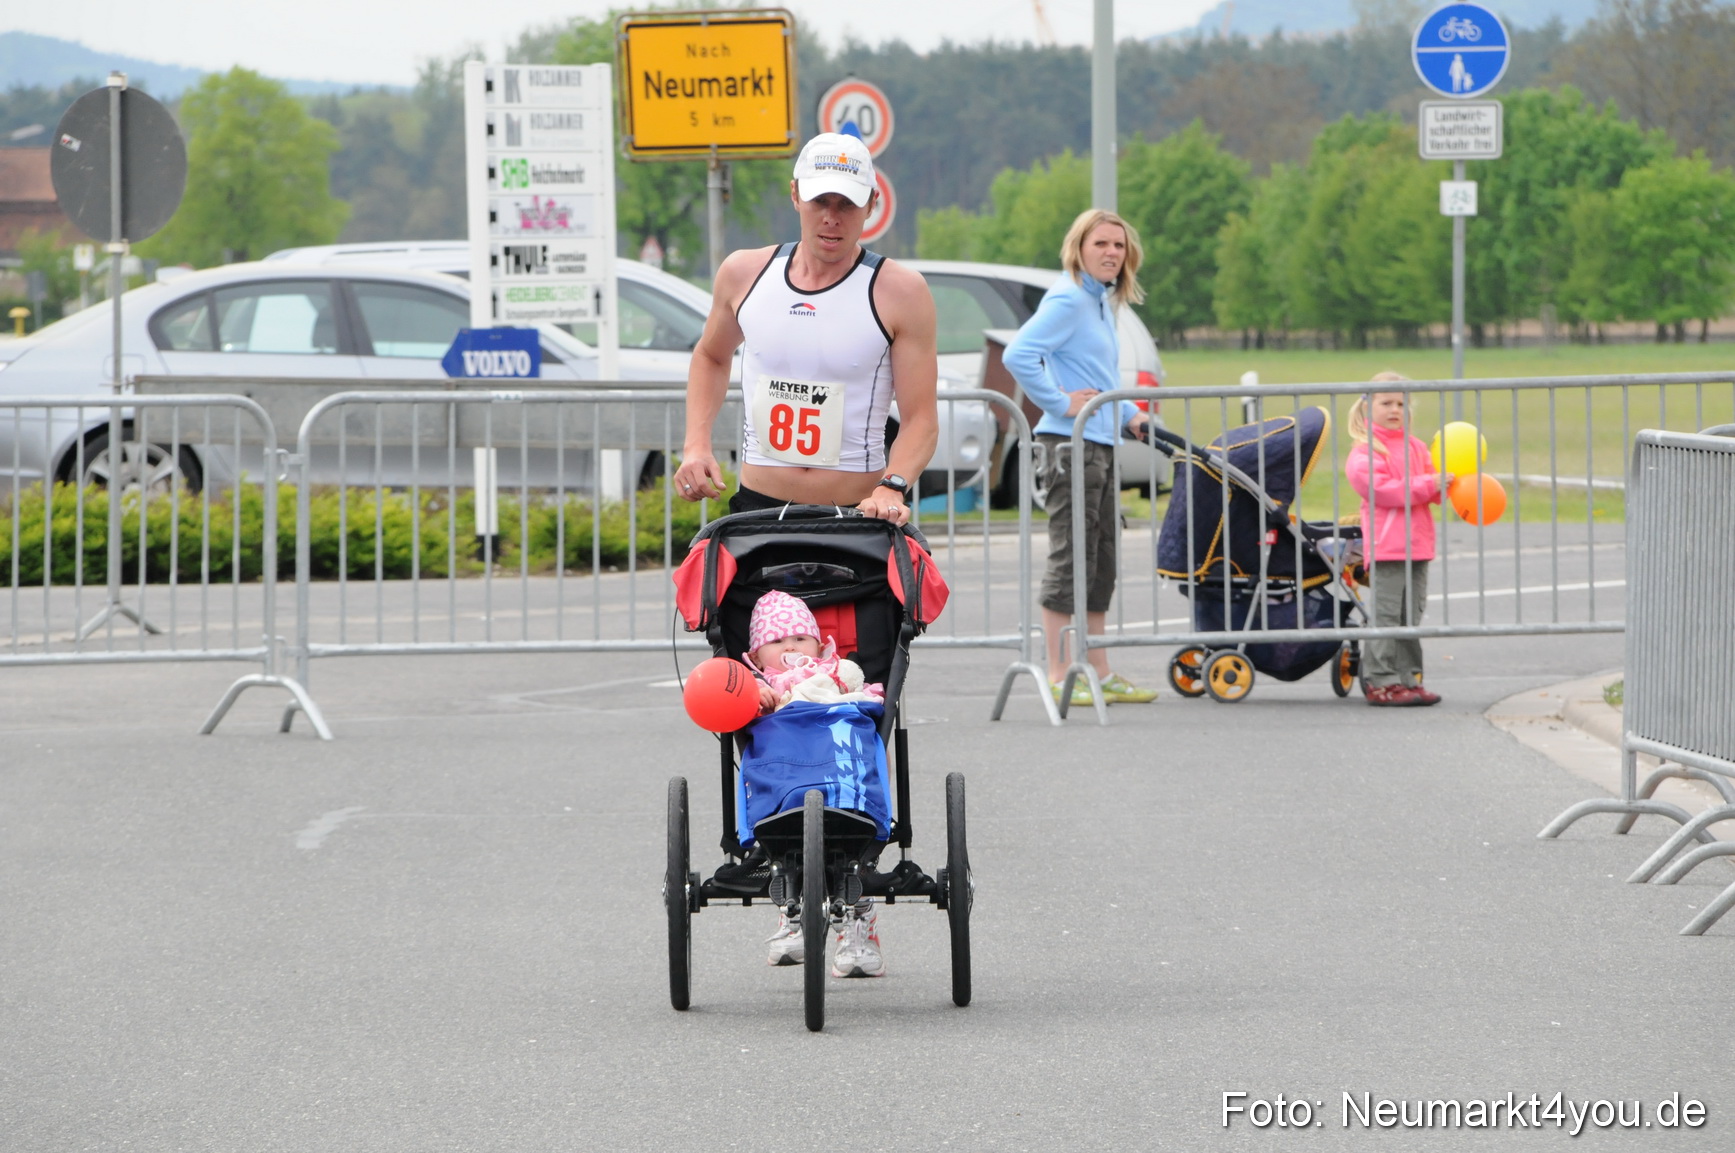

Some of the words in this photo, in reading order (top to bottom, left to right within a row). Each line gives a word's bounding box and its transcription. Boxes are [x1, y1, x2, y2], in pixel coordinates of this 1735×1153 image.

[685, 43, 731, 58] Nach
[643, 67, 774, 99] Neumarkt
[690, 111, 698, 126] 5
[712, 112, 735, 126] km
[504, 245, 547, 274] THULE
[461, 350, 532, 377] VOLVO
[769, 380, 809, 394] MEYER
[769, 390, 809, 402] WERBUNG
[768, 403, 821, 456] 85
